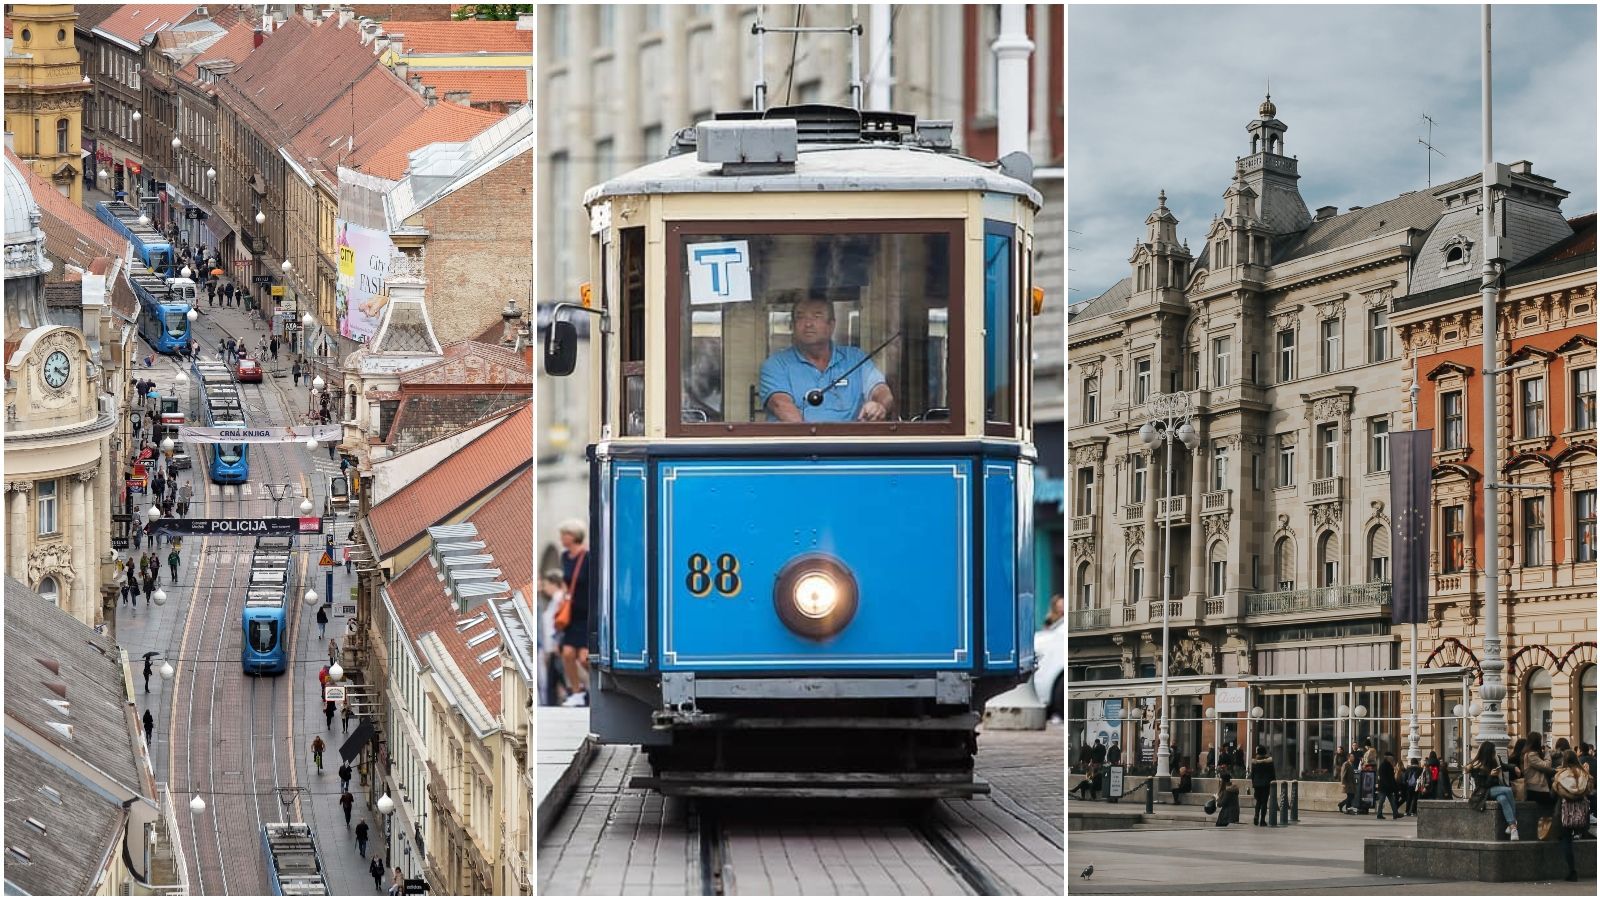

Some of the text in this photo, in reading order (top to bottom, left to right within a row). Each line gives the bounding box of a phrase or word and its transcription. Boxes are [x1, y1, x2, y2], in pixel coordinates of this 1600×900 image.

[340, 247, 354, 263] CITY
[694, 247, 742, 296] T
[211, 520, 267, 531] POLICIJA
[685, 553, 742, 597] 88
